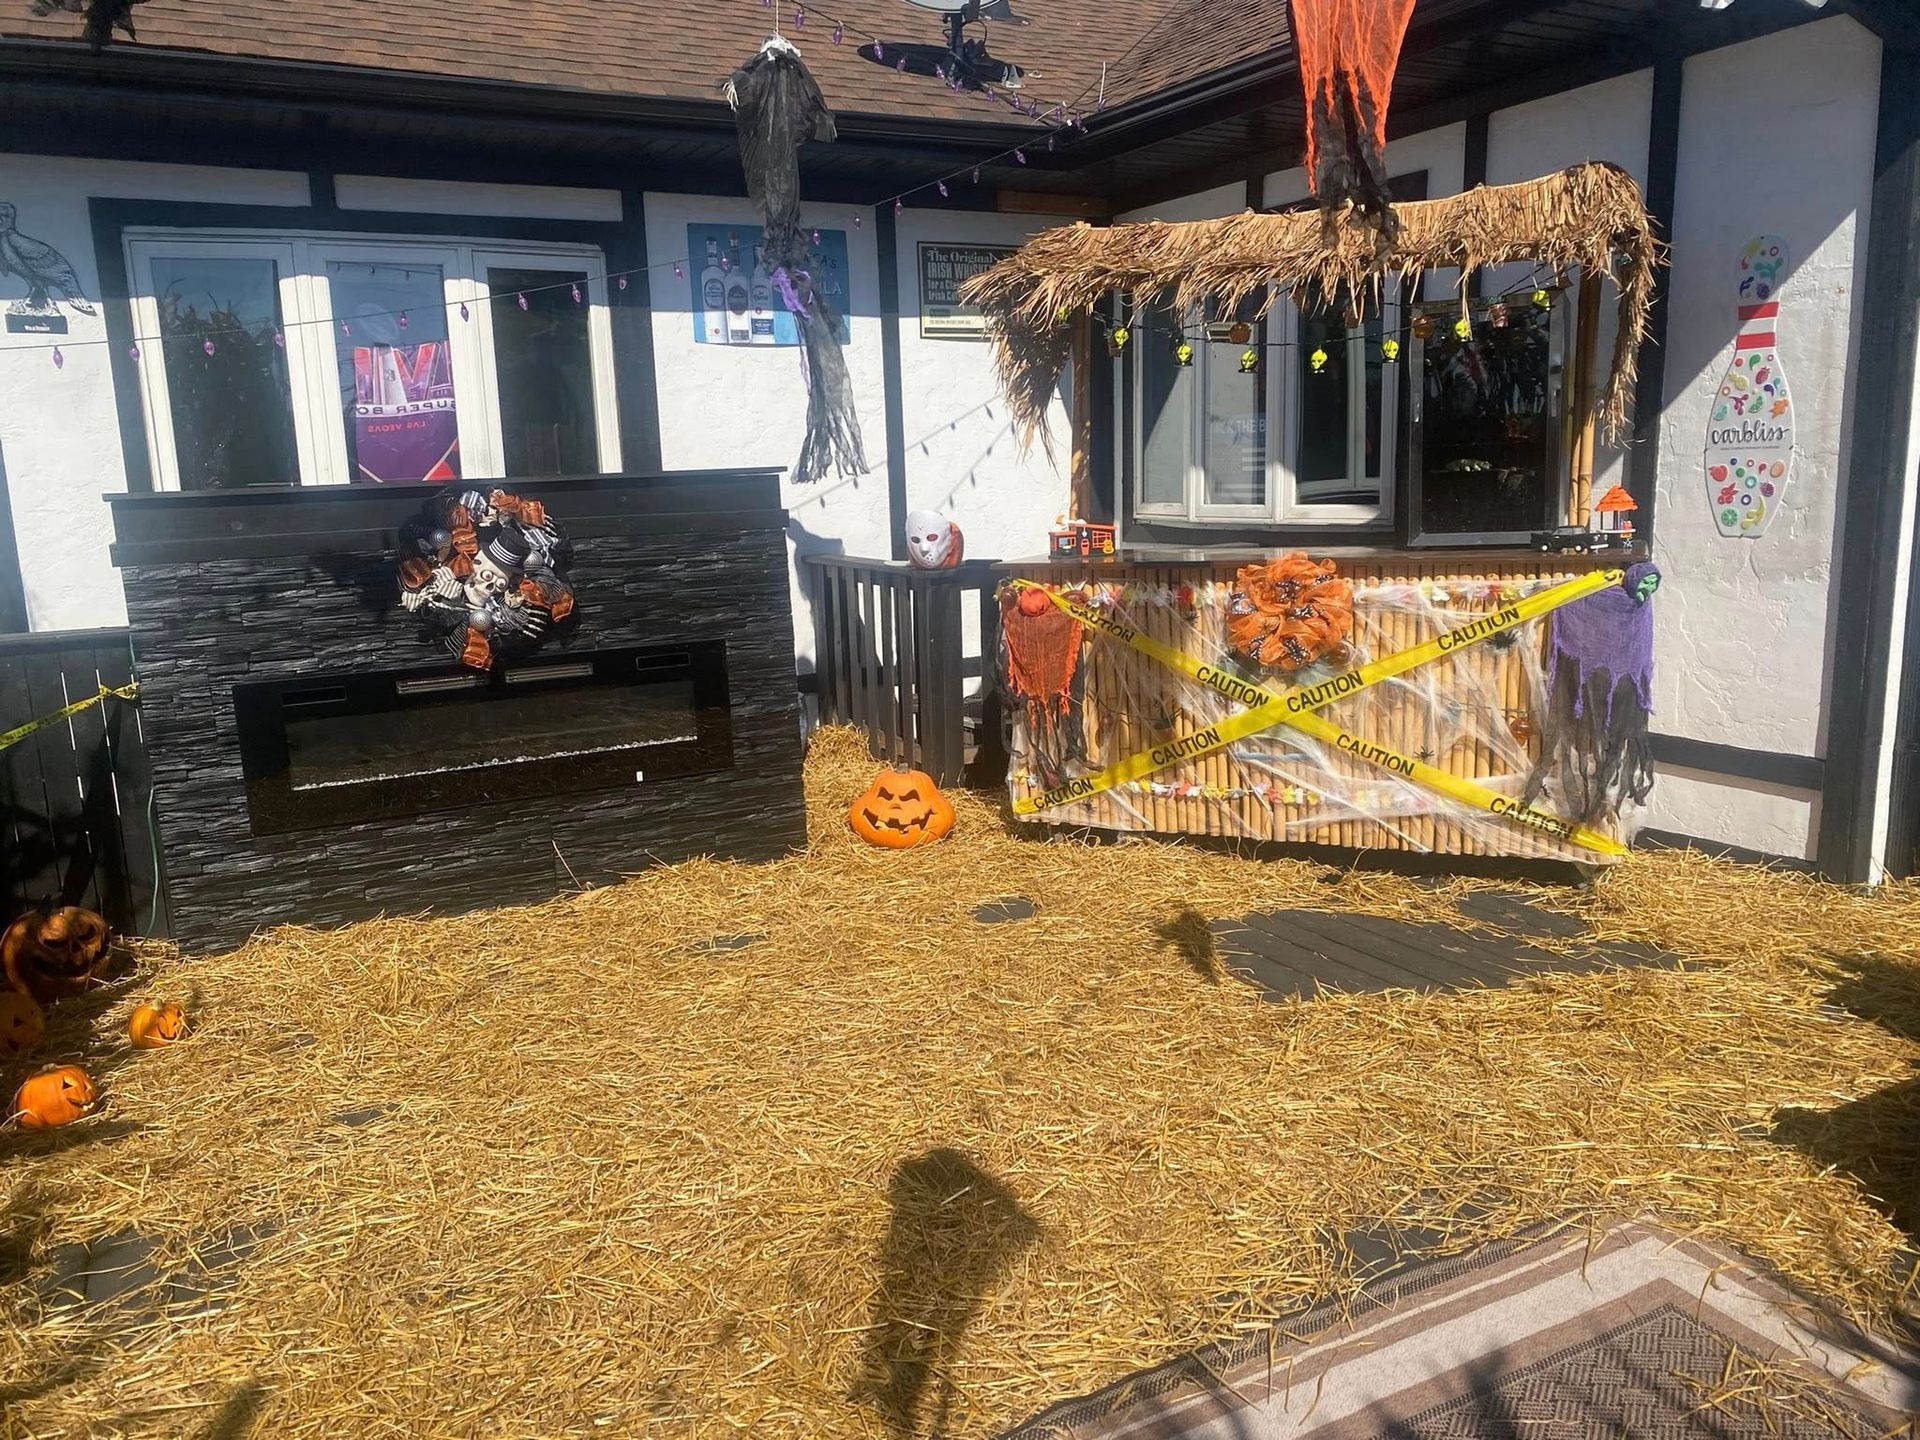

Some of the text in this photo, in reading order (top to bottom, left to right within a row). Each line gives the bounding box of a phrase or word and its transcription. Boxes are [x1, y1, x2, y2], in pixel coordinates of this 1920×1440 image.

[928, 248, 993, 264] The Original
[928, 262, 952, 279] IRISH
[928, 290, 946, 300] Irish
[1712, 419, 1790, 444] carbliss
[1070, 605, 1135, 642] CAUTION
[1437, 608, 1519, 650] CAUTION
[1196, 666, 1269, 708] CAUTION
[1287, 670, 1364, 712] CAUTION
[1152, 728, 1221, 765] CAUTION
[1336, 734, 1415, 776] CAUTION
[1034, 777, 1094, 809] CAUTION
